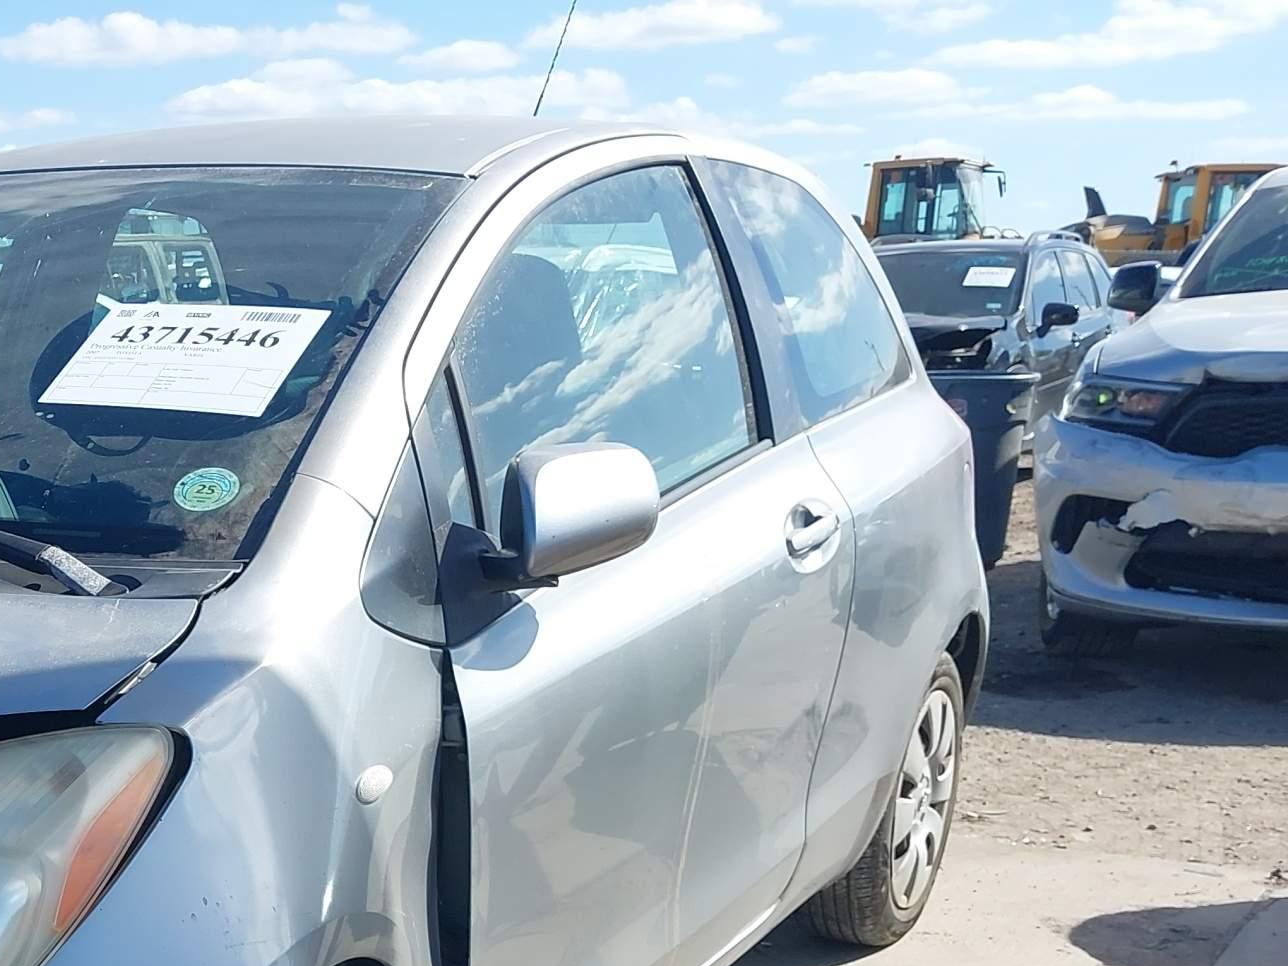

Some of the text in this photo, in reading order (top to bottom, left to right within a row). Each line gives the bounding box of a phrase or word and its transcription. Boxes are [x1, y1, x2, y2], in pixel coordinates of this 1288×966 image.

[111, 325, 287, 349] 43715446
[141, 344, 176, 352] Casualty
[180, 345, 223, 353] Insurance
[195, 484, 217, 495] 25
